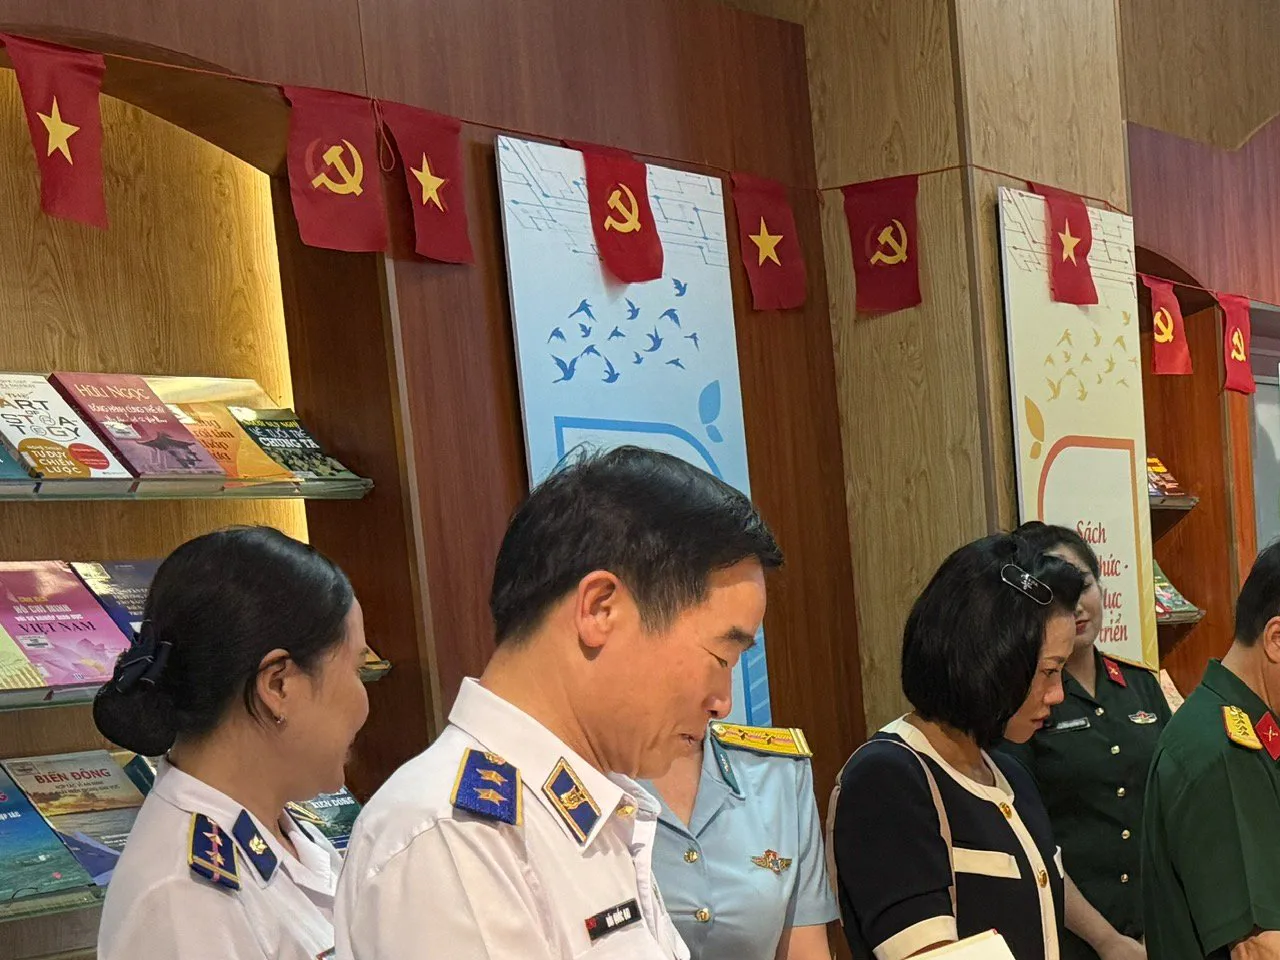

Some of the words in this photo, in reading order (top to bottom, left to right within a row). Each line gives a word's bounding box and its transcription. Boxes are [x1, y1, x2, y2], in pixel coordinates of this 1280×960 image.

[75, 383, 110, 398] HỮU
[110, 385, 150, 401] NGỌC
[31, 450, 46, 458] TƯ
[47, 450, 68, 460] DUY
[39, 457, 74, 466] CHIẾN
[46, 466, 82, 475] LƯỢC
[1076, 520, 1107, 544] Sách
[1103, 588, 1122, 614] lực
[13, 604, 29, 613] HỒ
[28, 604, 47, 613] CHÍ
[46, 604, 72, 613] MINH
[18, 622, 56, 635] VIỆT
[58, 621, 97, 631] NAM
[34, 770, 70, 784] BIỂN
[71, 767, 111, 781] ĐÔNG
